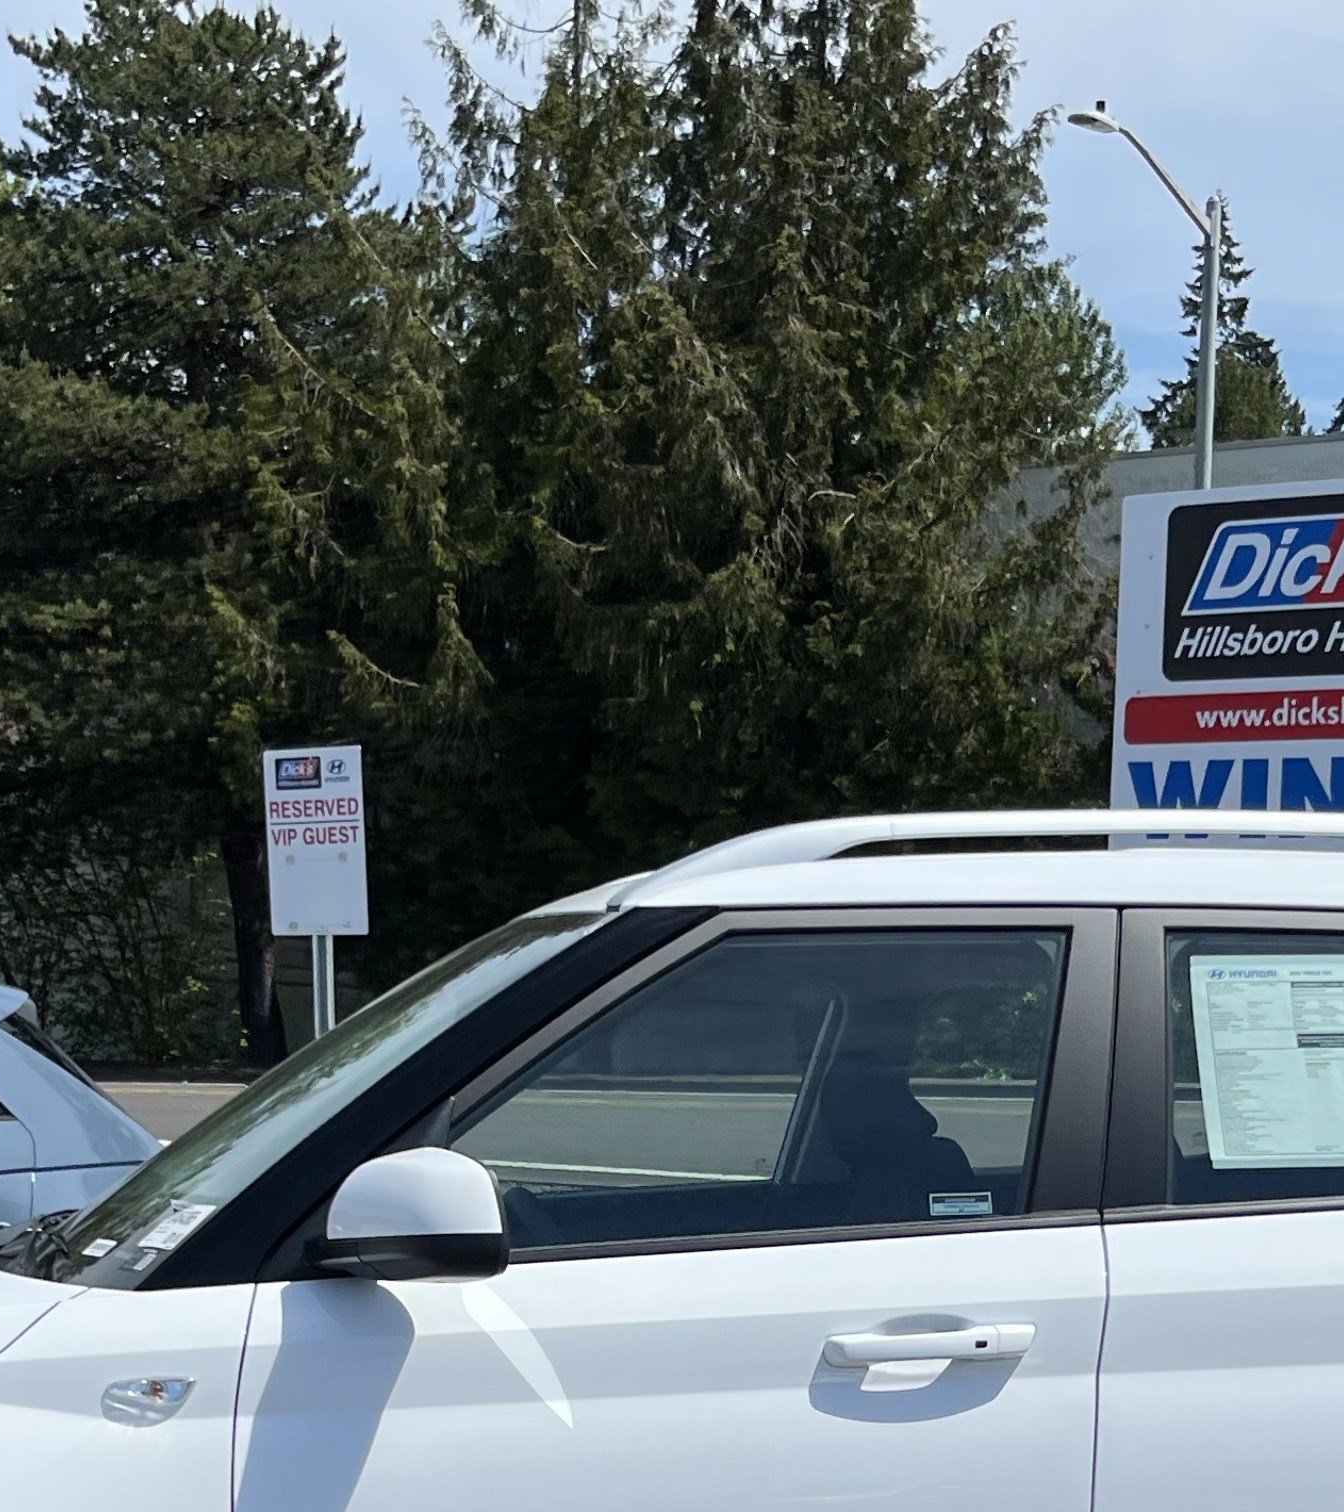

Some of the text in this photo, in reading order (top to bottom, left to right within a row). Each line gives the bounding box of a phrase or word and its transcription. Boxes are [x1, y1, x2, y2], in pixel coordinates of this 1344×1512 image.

[1174, 624, 1320, 659] Hillsboro
[269, 798, 359, 819] RESERVED
[271, 826, 359, 846] VIP GUEST
